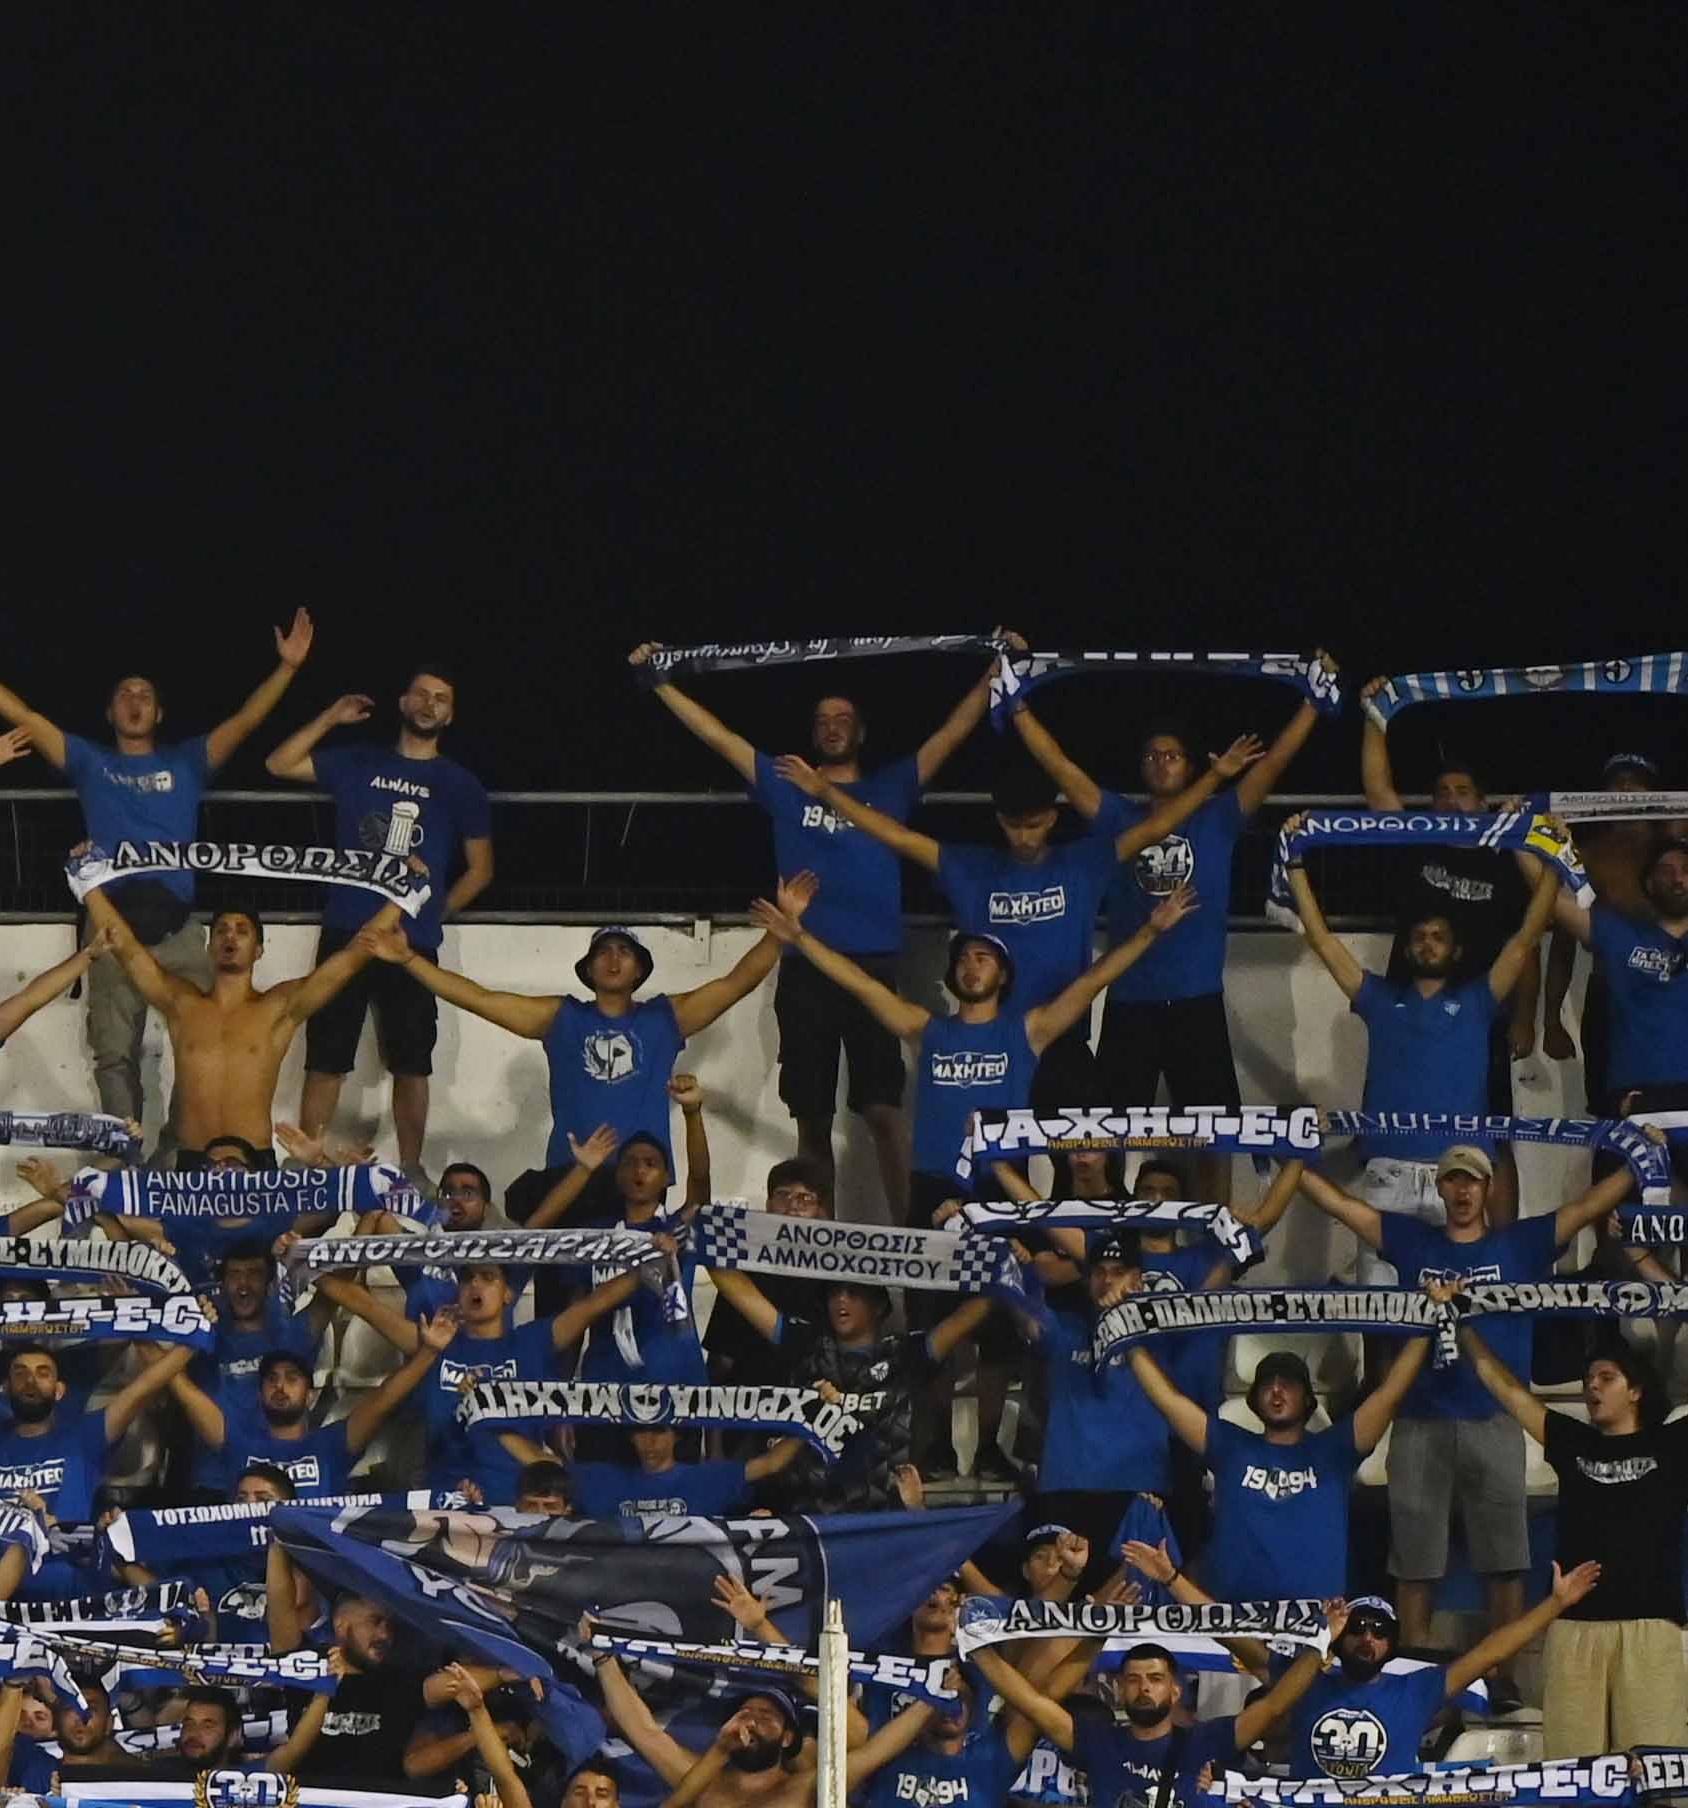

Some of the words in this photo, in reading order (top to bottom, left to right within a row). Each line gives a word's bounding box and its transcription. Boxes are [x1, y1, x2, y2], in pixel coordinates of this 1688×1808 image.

[370, 775, 431, 797] ALWAYS
[113, 840, 411, 896] ΑΝΟΡΘΩΣΙΣ
[147, 1169, 328, 1191] ANORTHOSIS
[147, 1190, 285, 1216] FAMAGUSTA
[774, 1223, 927, 1255] ΑΝΟΡΘΩΣΙΣ
[756, 1246, 940, 1281] ΑΜΜΟΧΩΣΤΟΥ
[1007, 1601, 1322, 1636] ΑΝΟΡΘΩΣΙΣ
[1318, 1729, 1382, 1761] 30
